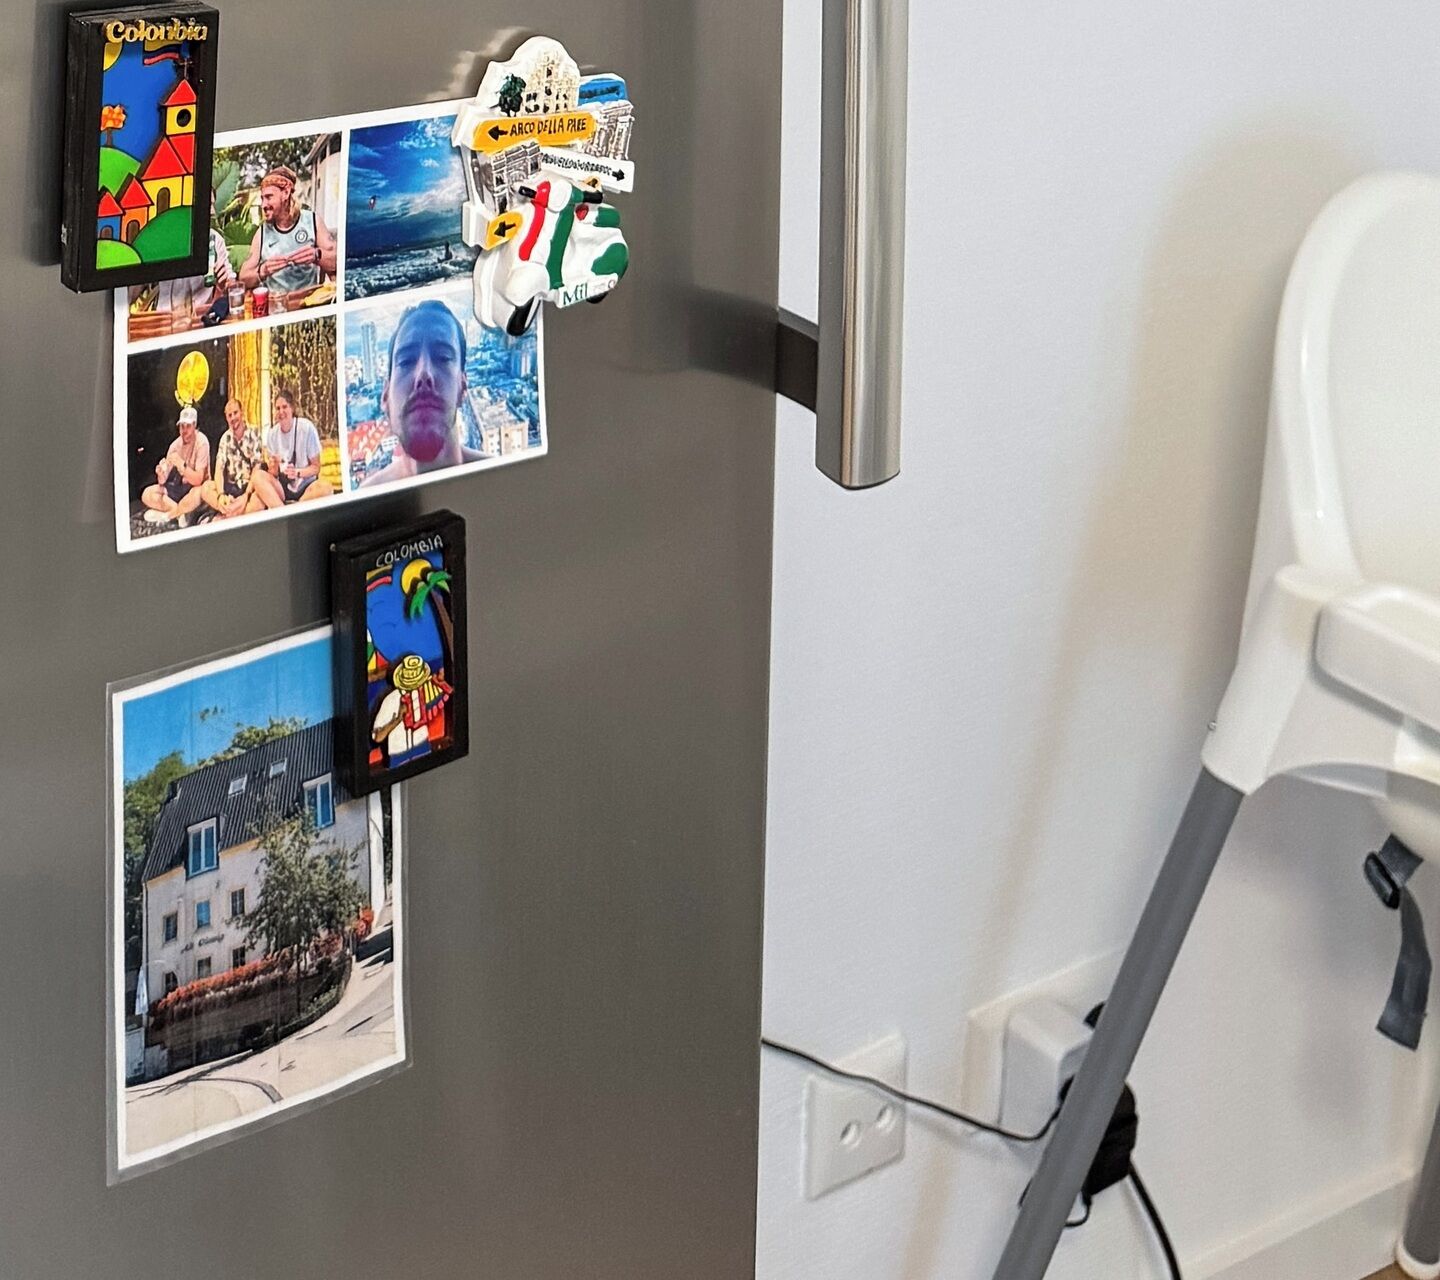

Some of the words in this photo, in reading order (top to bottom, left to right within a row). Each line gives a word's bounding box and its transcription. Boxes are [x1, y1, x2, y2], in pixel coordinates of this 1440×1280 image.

[509, 121, 536, 137] ARCO
[537, 117, 564, 135] DELLA
[375, 534, 444, 569] COLOMBIA
